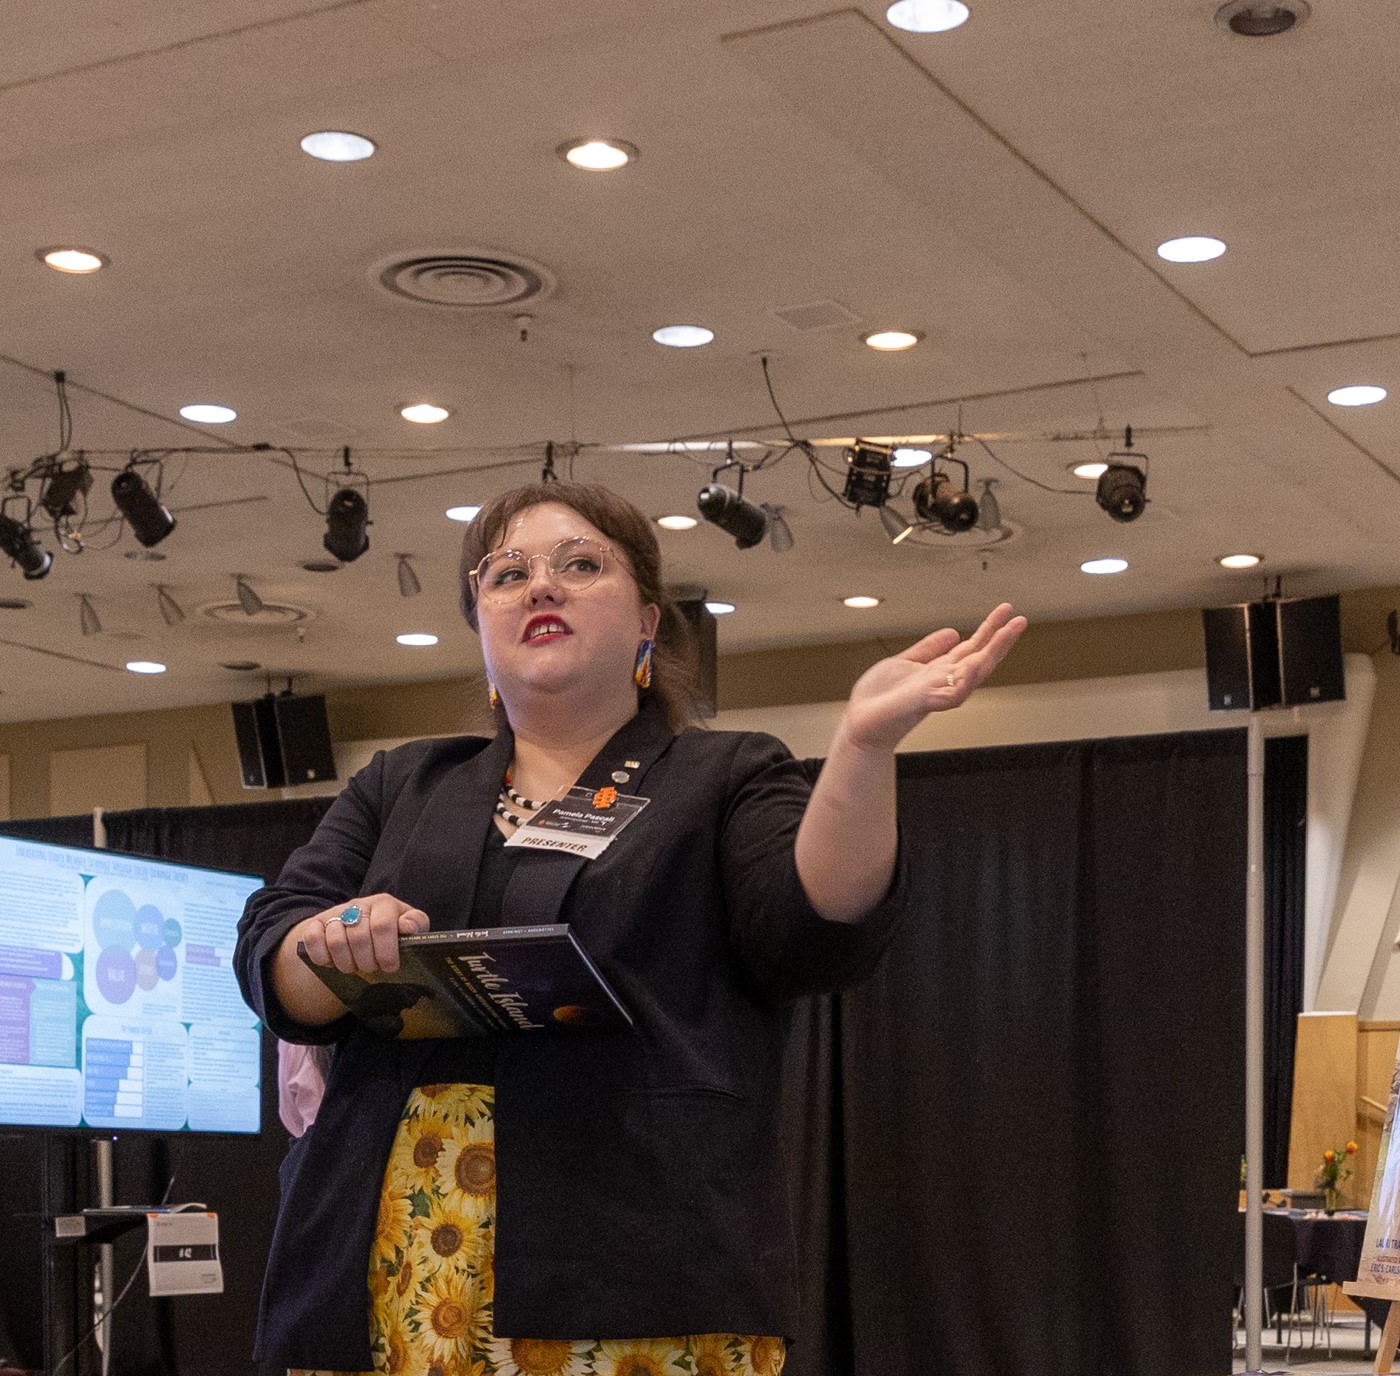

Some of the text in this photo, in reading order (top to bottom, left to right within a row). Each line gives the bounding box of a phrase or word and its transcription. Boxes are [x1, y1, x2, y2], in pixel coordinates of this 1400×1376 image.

[553, 808, 584, 819] Pamela
[522, 837, 588, 852] PRESENTER
[458, 951, 509, 991] Turtle
[488, 992, 545, 1031] Island
